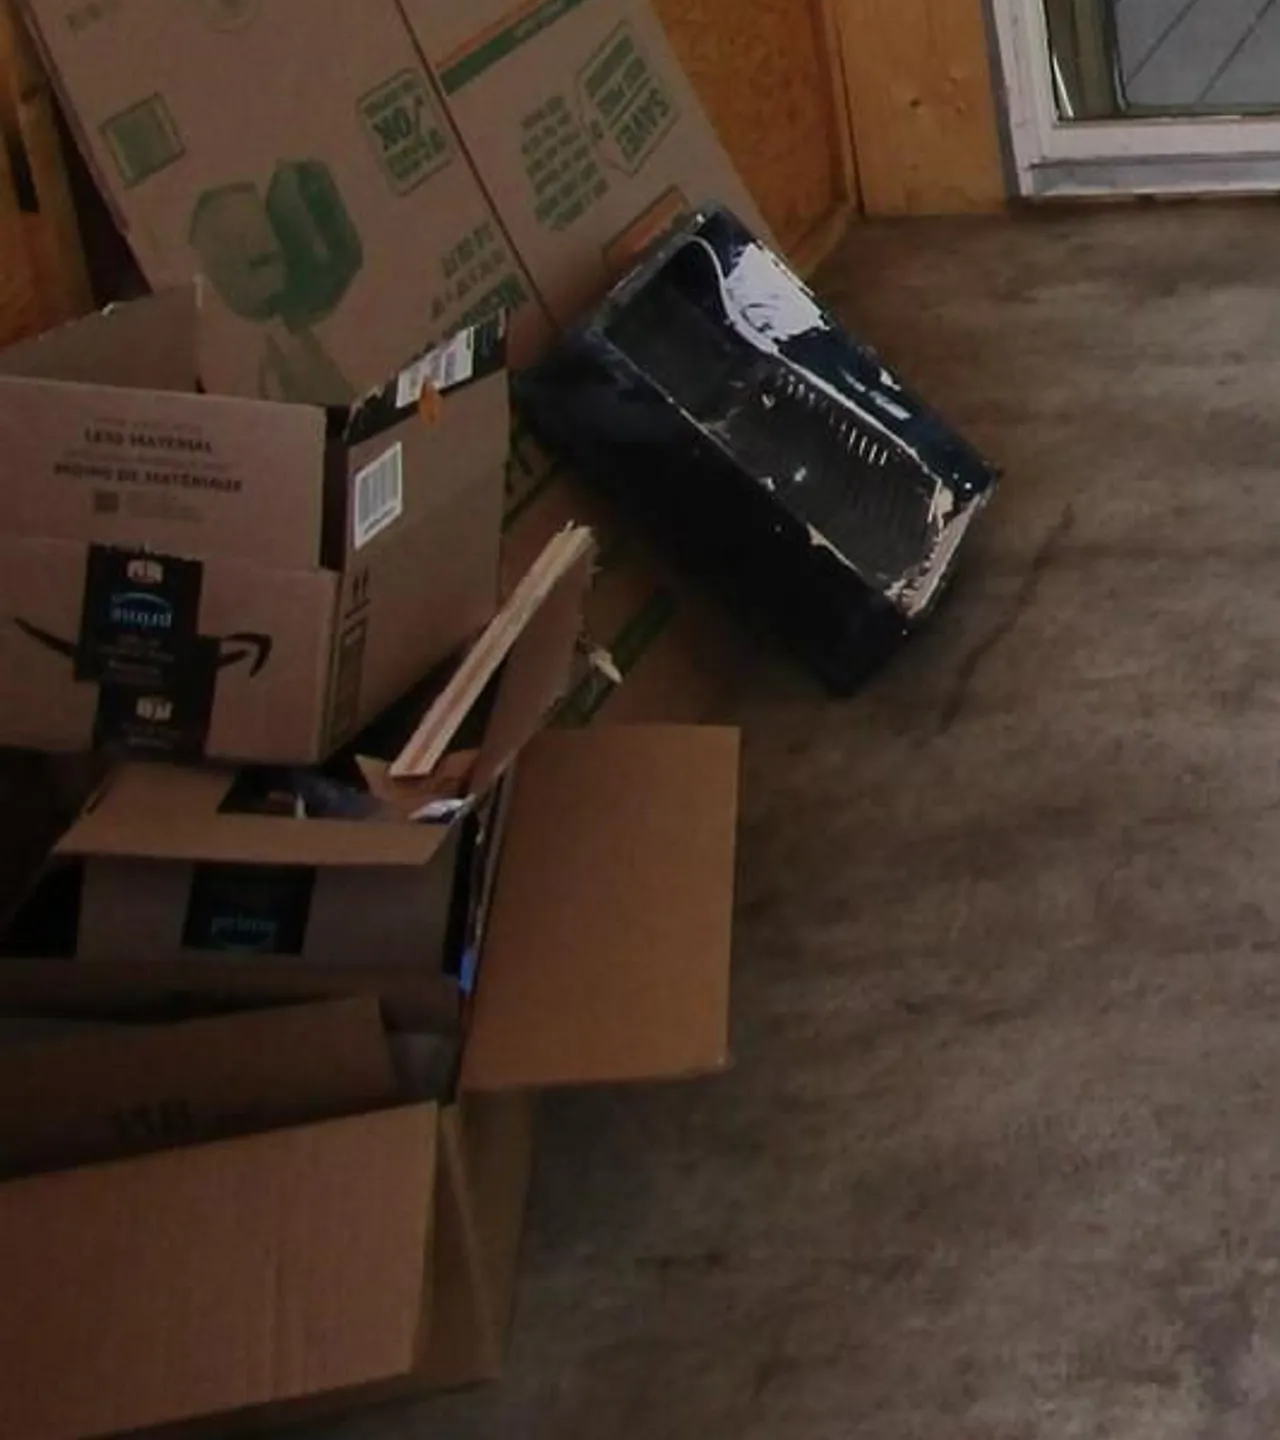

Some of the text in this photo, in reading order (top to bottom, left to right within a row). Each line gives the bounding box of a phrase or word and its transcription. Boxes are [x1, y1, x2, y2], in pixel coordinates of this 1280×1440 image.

[84, 428, 213, 453] LESS MATERIAL
[110, 606, 173, 629] prime
[211, 911, 278, 936] prime
